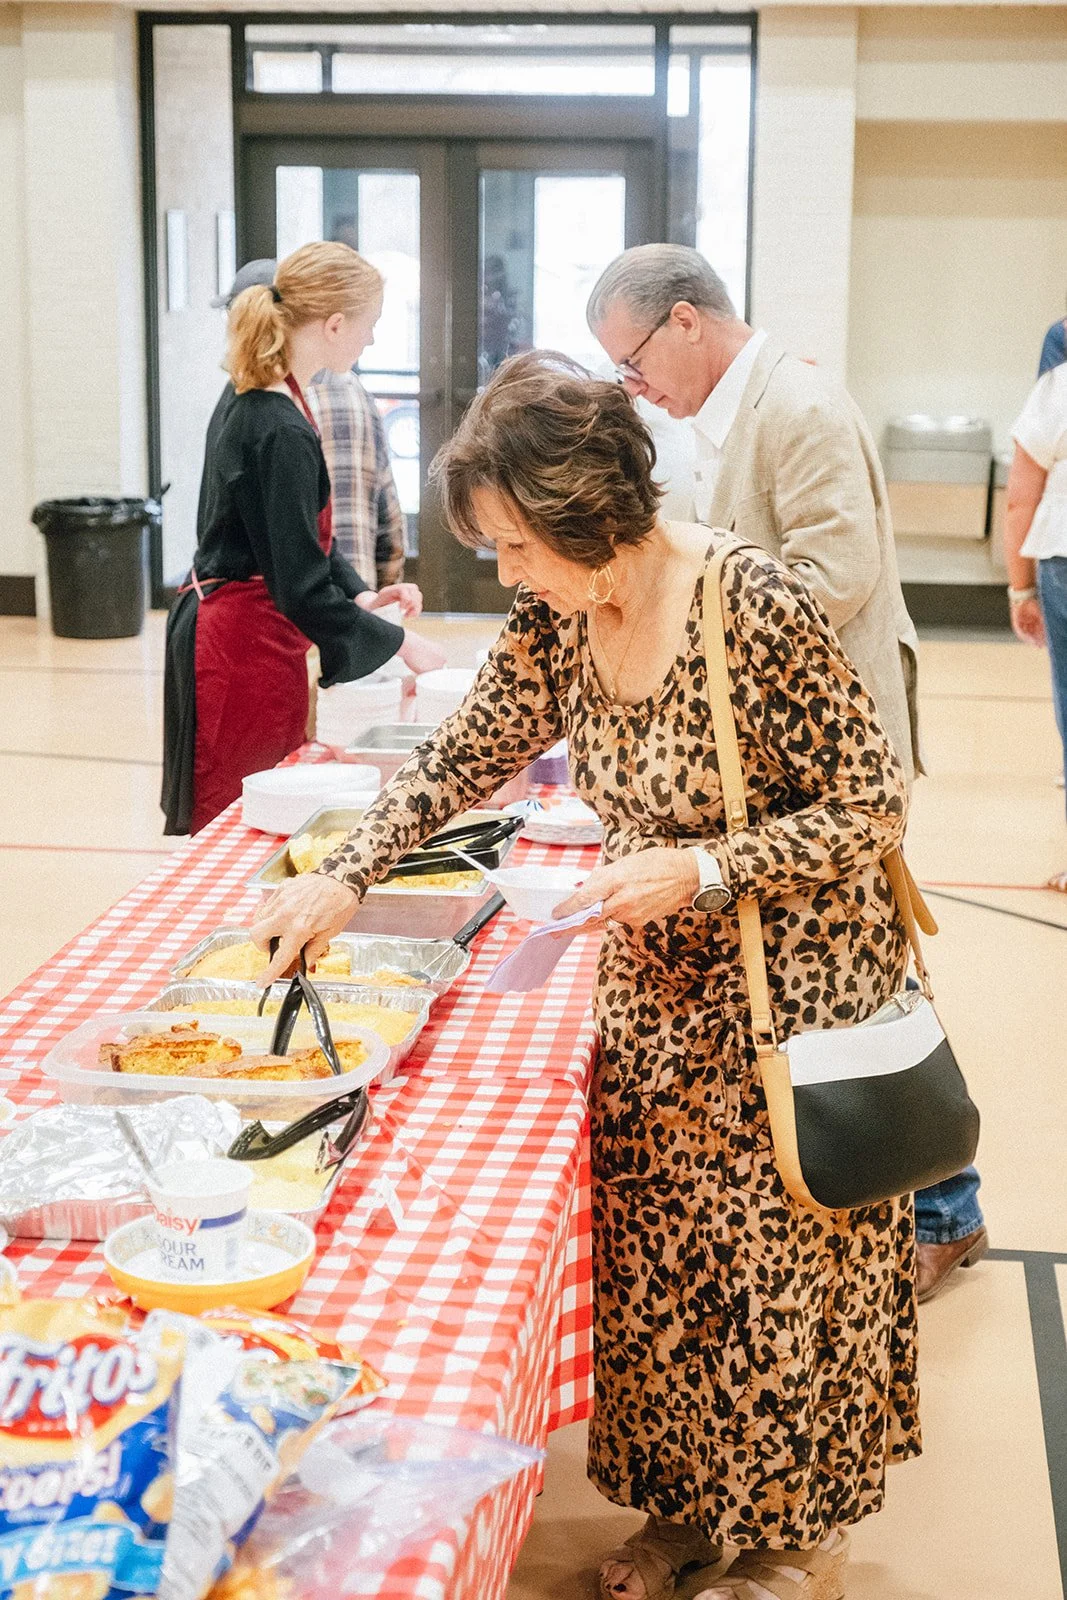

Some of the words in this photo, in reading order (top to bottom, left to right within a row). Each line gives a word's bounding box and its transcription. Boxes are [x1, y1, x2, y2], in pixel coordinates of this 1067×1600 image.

[156, 1207, 199, 1236] aisy
[157, 1236, 197, 1256] OUR
[160, 1251, 205, 1271] REAM
